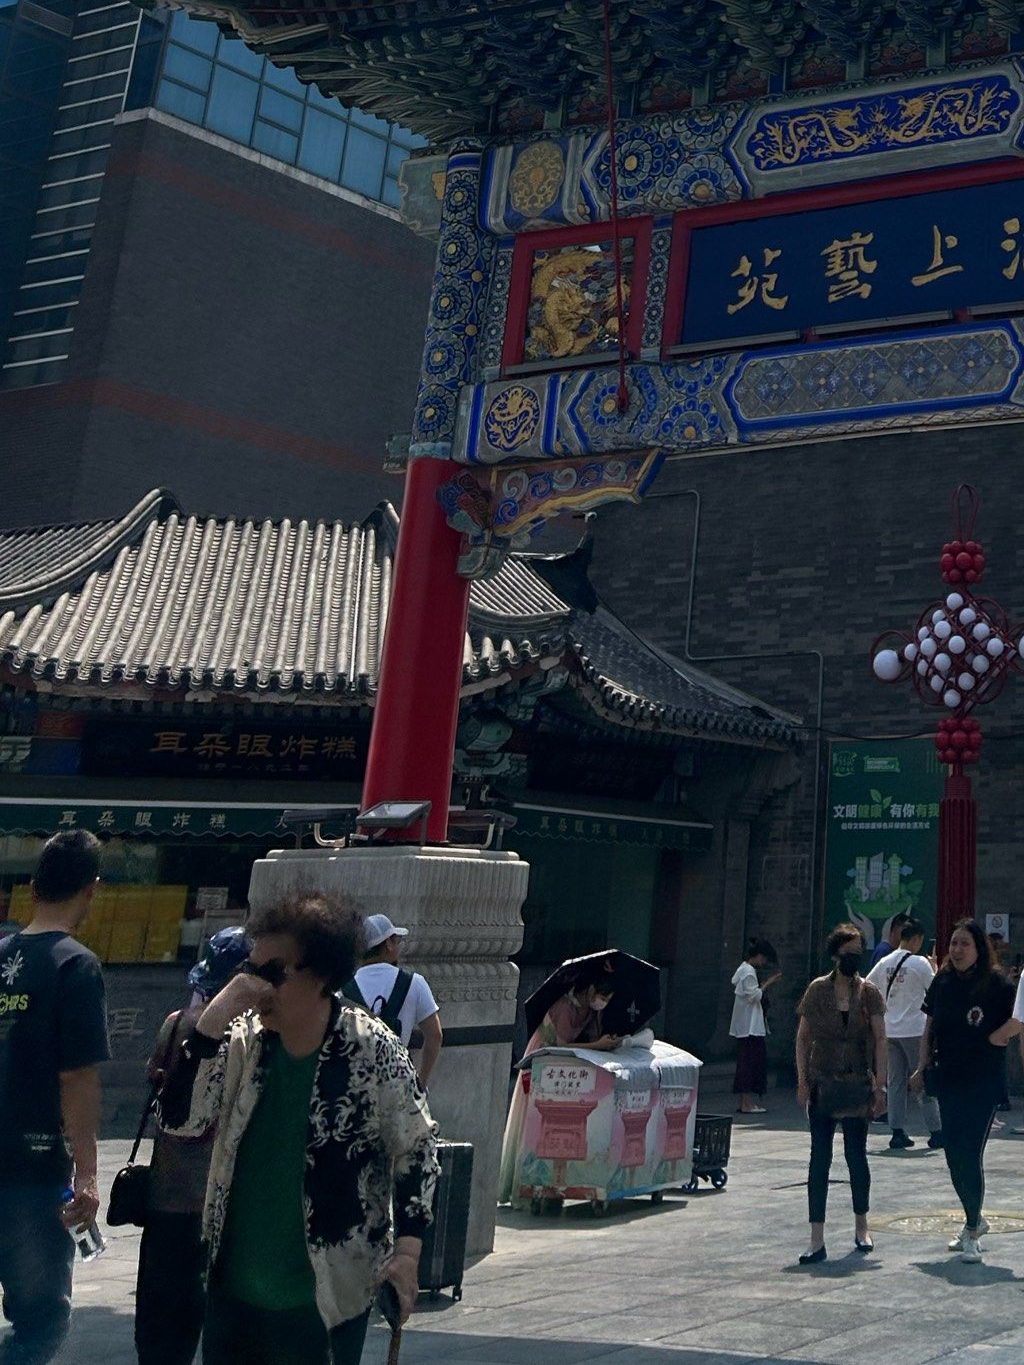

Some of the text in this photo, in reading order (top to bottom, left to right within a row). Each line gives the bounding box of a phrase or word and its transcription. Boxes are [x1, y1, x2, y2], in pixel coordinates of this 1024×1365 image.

[150, 731, 357, 761] 耳朵眼炸糕
[58, 811, 226, 830] 耳朵眼炸糕
